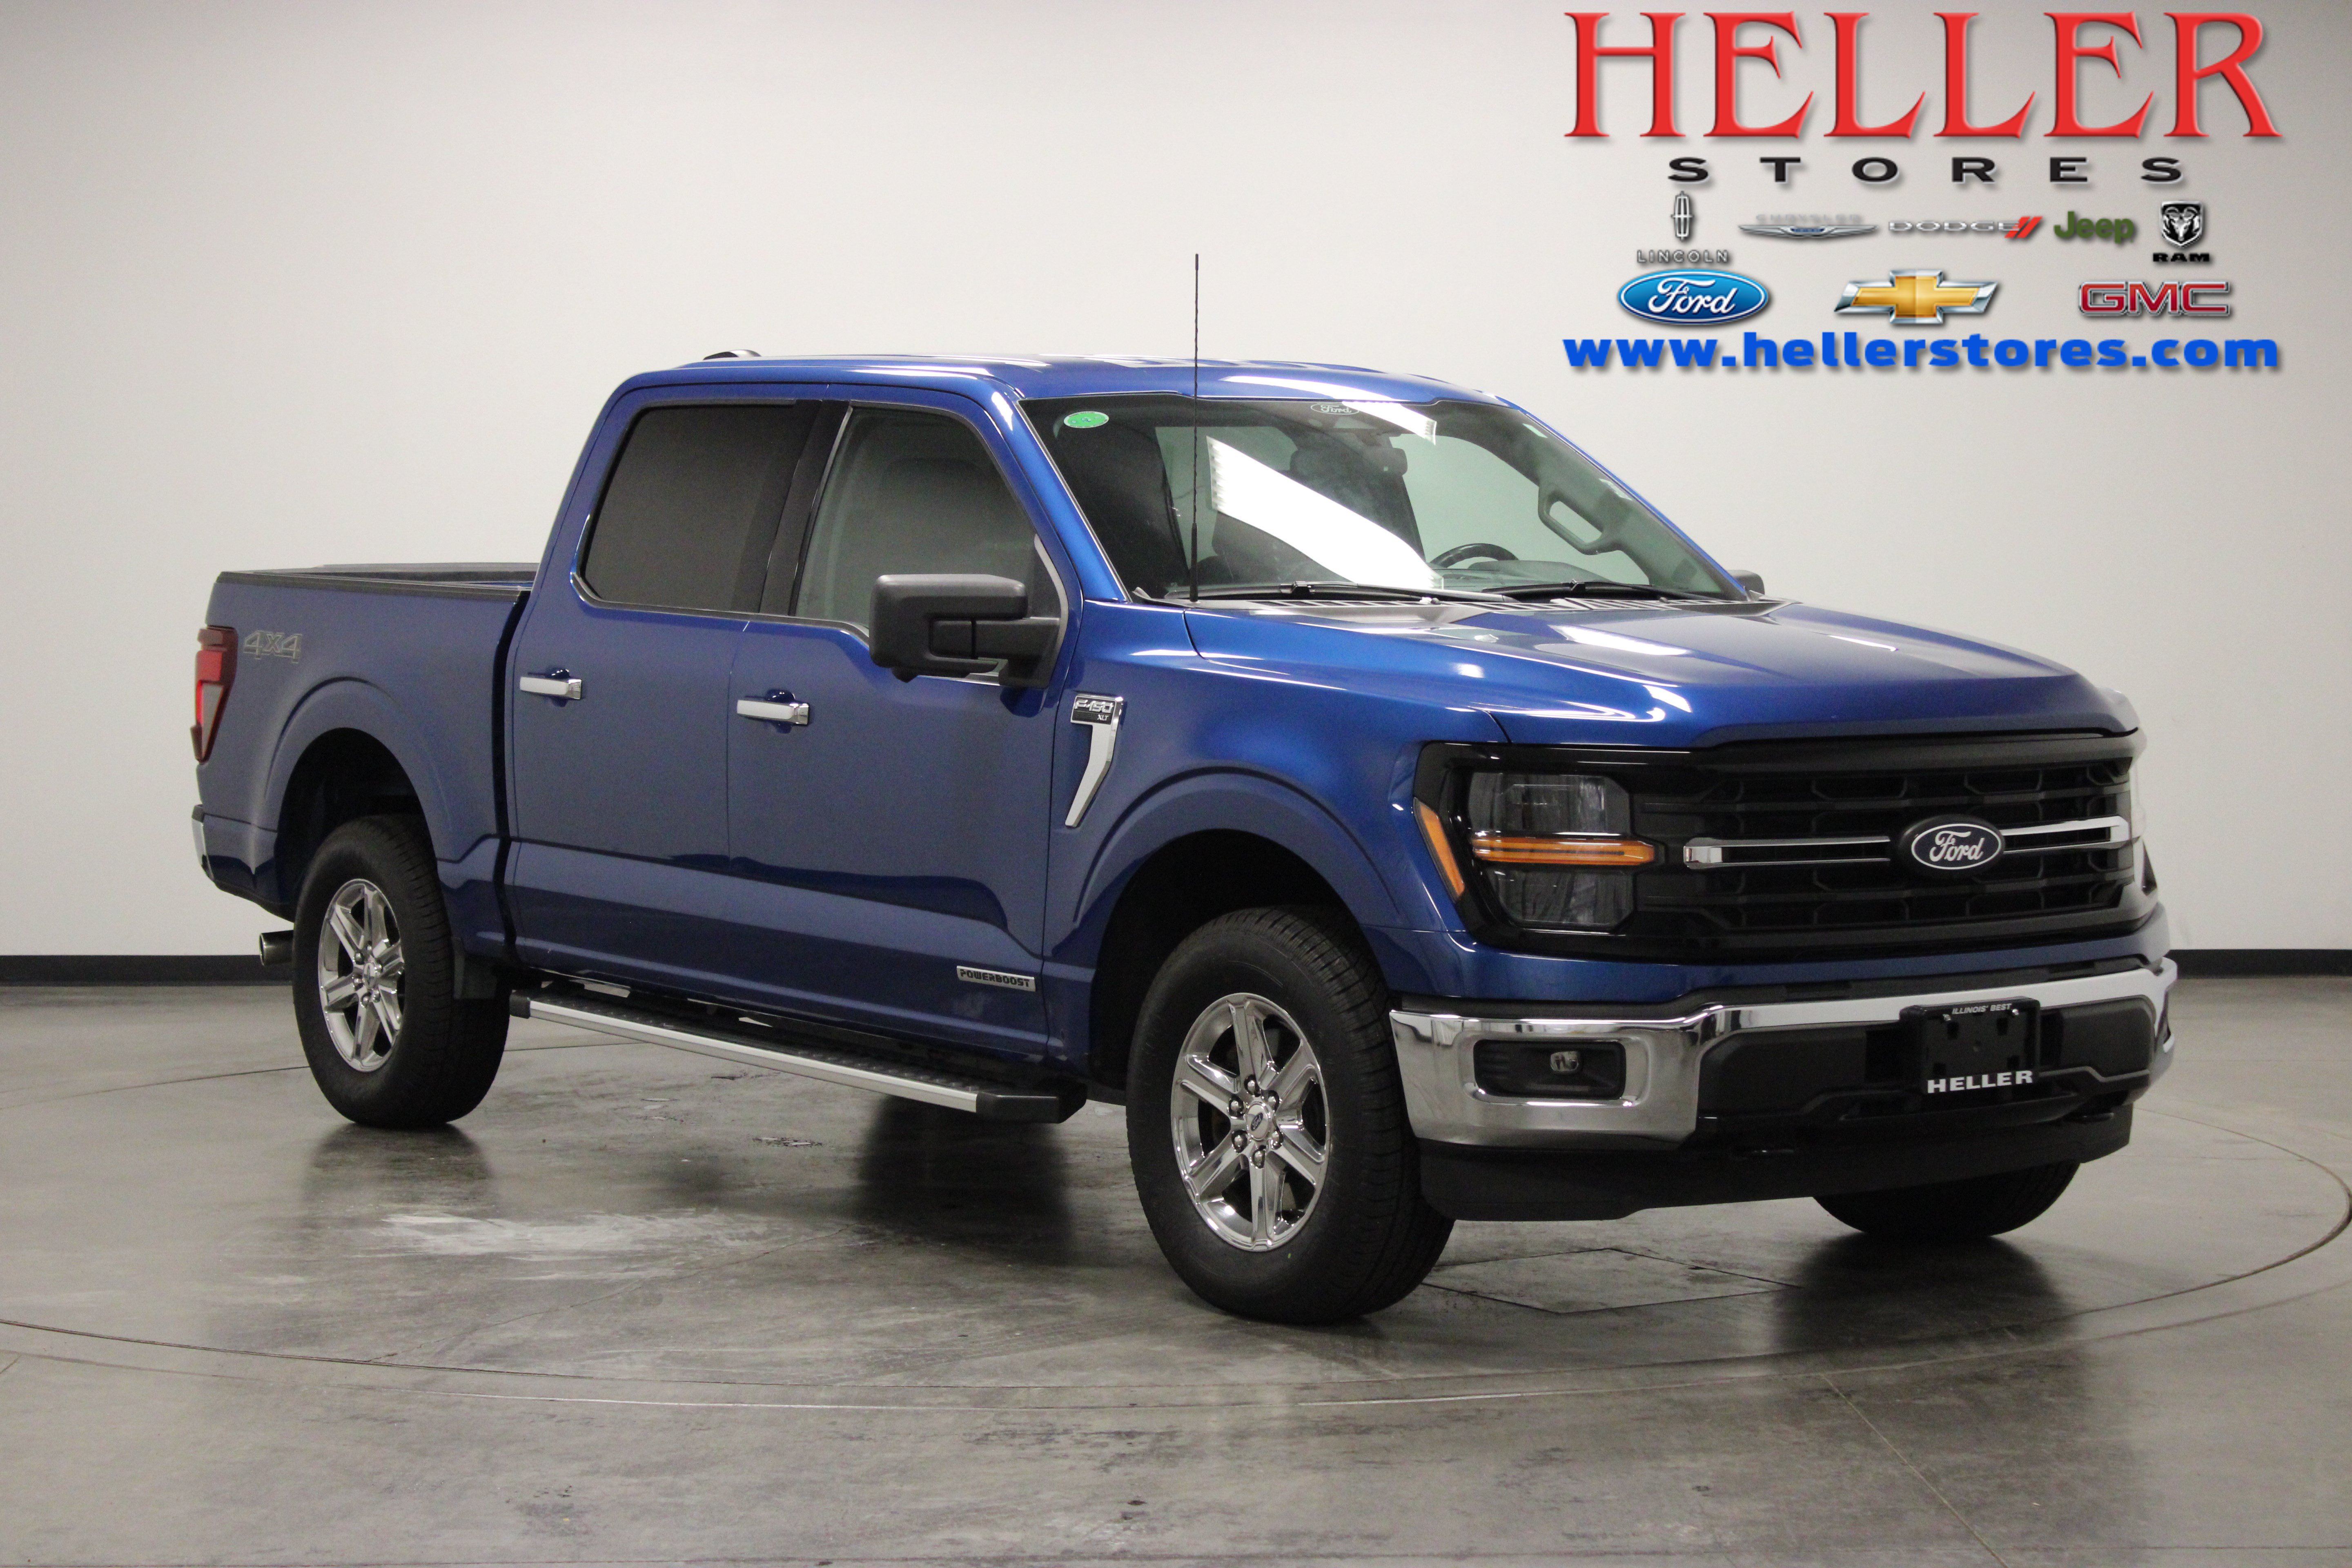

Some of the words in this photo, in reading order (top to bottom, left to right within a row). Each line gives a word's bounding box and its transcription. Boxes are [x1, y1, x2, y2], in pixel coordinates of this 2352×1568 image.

[1321, 405, 1352, 413] Ford
[1074, 699, 1114, 713] F-150
[1929, 831, 1985, 862] Ford
[960, 969, 1030, 987] POWERBOOST
[1990, 1003, 2012, 1011] BEST
[1927, 1070, 2033, 1094] HELLER
